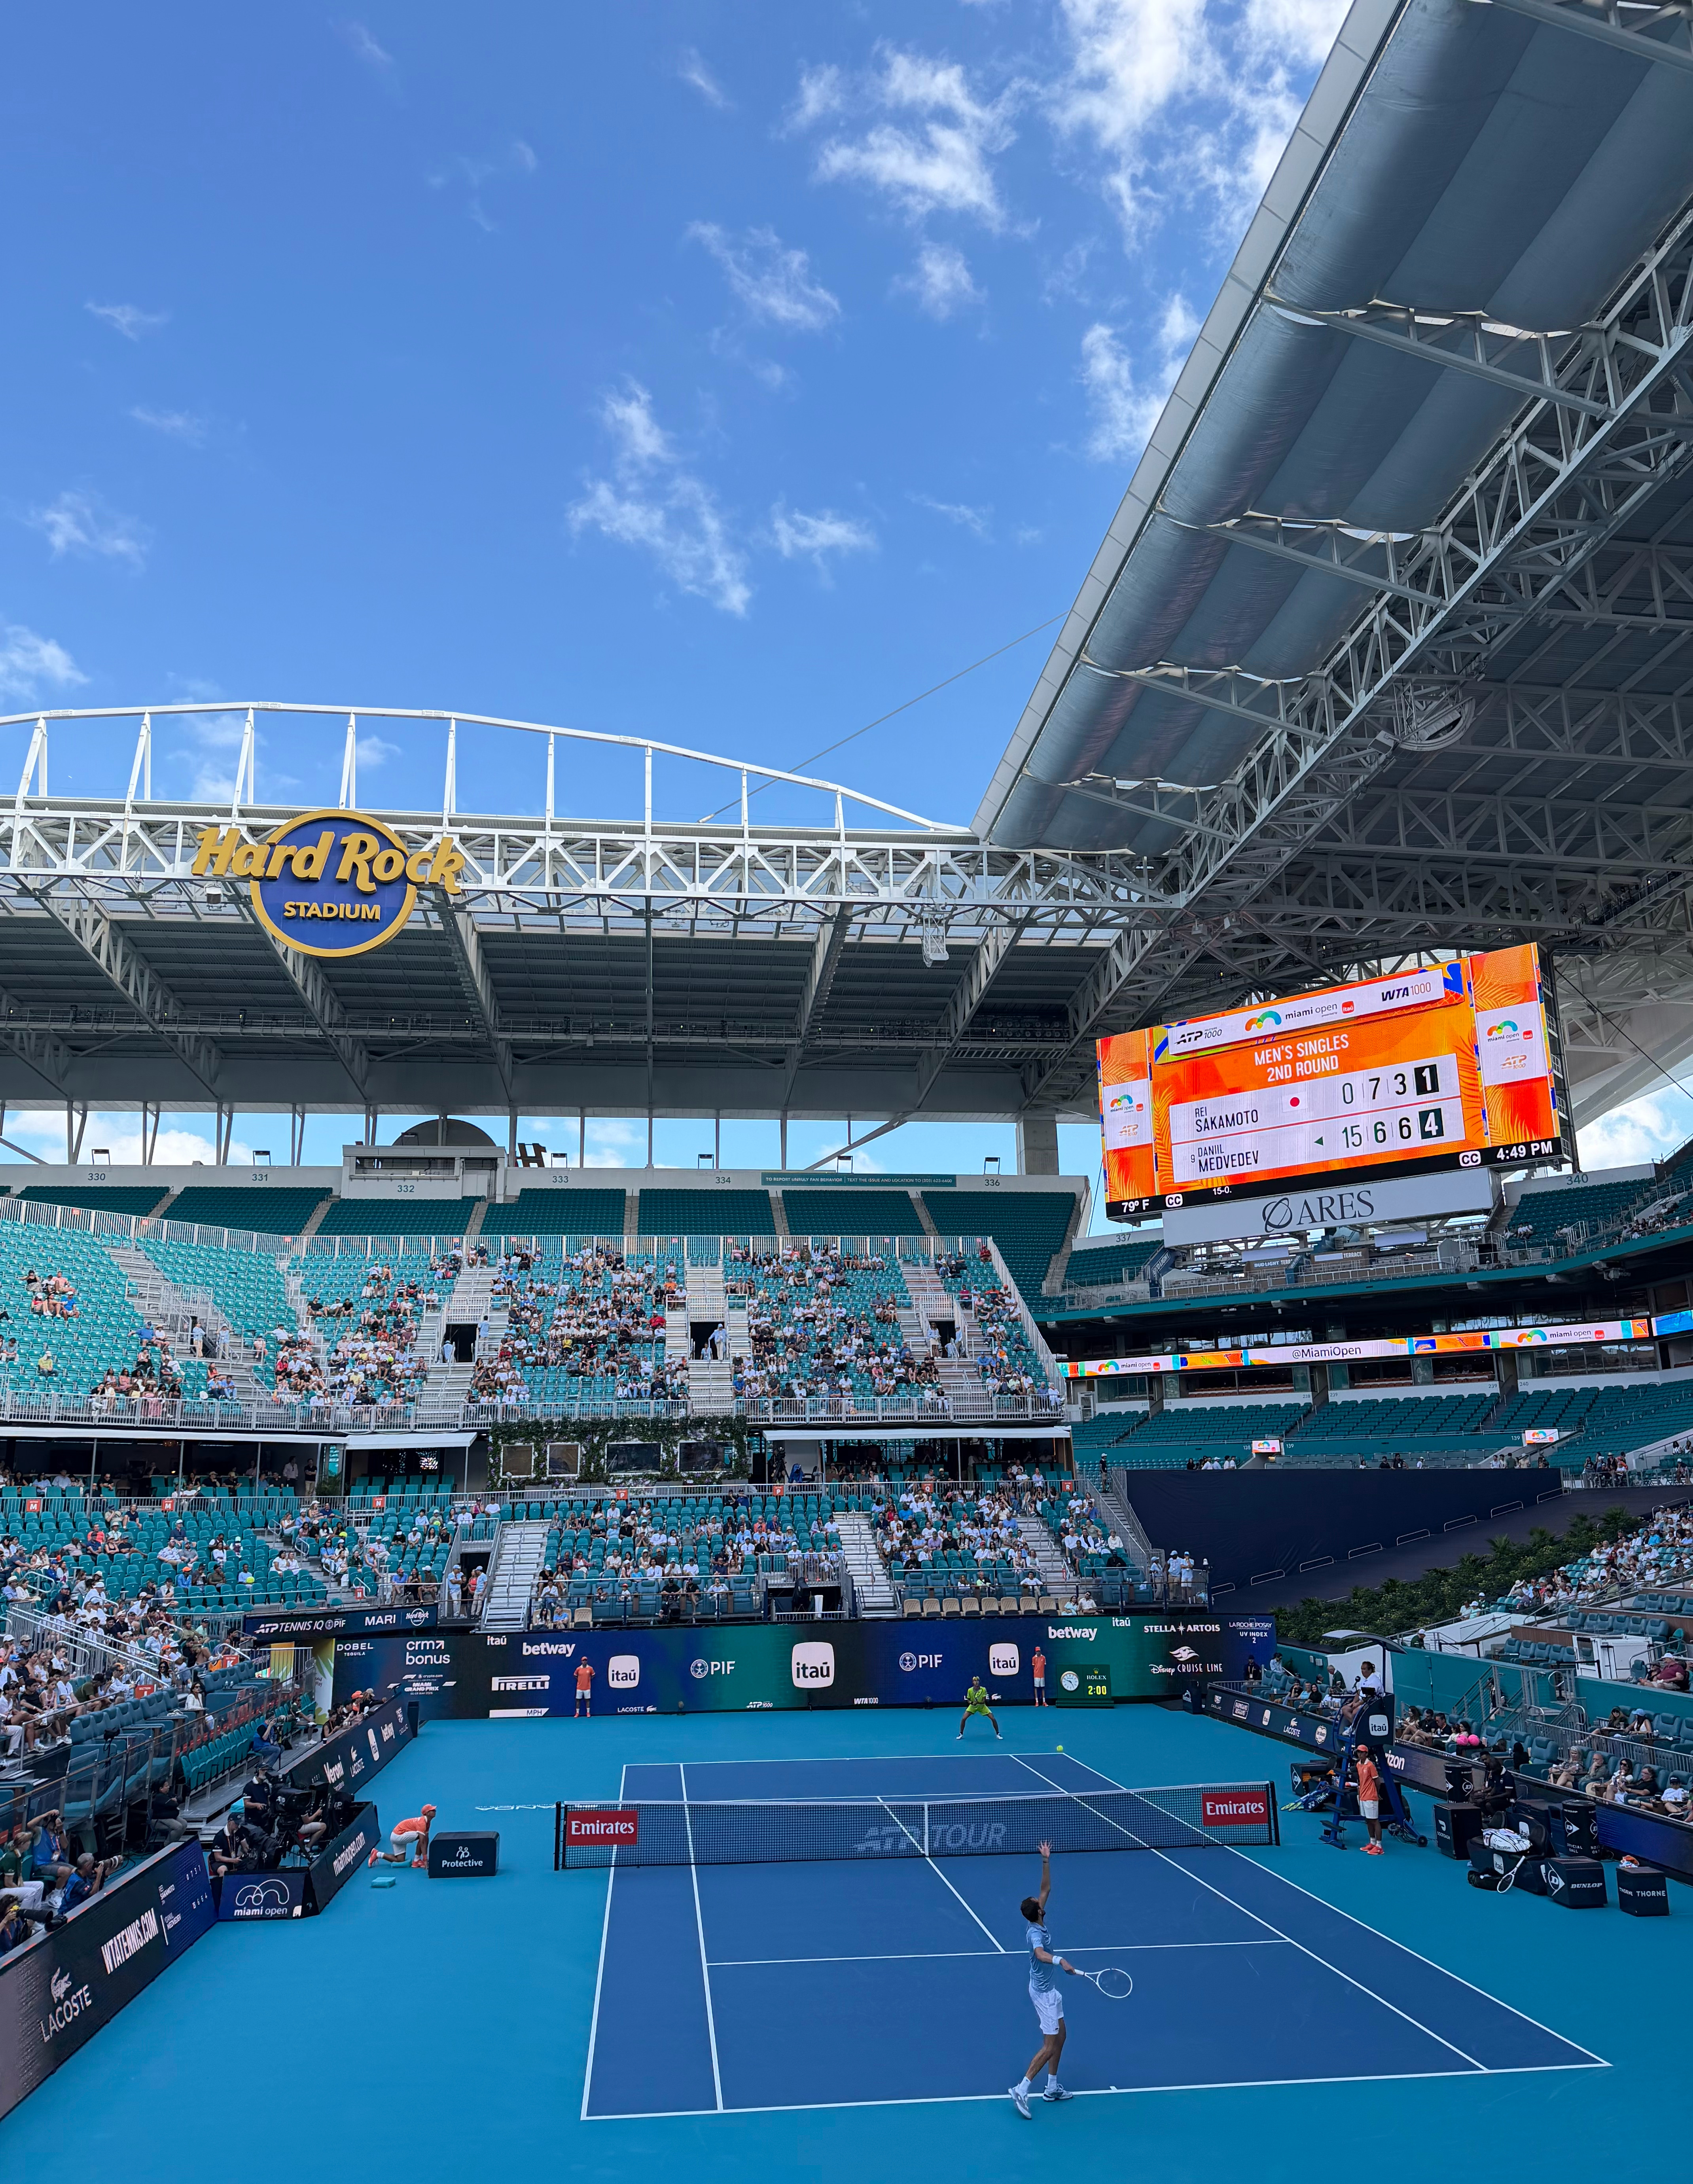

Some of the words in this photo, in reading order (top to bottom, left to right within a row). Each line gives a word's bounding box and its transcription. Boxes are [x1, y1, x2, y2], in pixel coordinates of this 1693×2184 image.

[191, 827, 335, 882] Hard
[335, 832, 465, 895] Rock
[283, 901, 381, 921] STADIUM
[1382, 987, 1409, 1001] WTA
[1410, 982, 1432, 995] 1000
[1285, 1007, 1313, 1020] miami
[1315, 1003, 1338, 1014] open
[1174, 1029, 1203, 1045] ATP
[1204, 1028, 1222, 1039] 1000
[1254, 1045, 1293, 1065] MEN'S
[1297, 1033, 1350, 1056] SINGLES
[1500, 1054, 1527, 1066] ATP
[1267, 1062, 1292, 1082] 2ND
[1296, 1055, 1339, 1076] ROUND
[1196, 1109, 1259, 1132] SAKAMOTO
[1342, 1083, 1353, 1104] 0
[1369, 1077, 1380, 1100] 7
[1394, 1073, 1407, 1095] 3
[1422, 1068, 1432, 1091] 1
[1195, 1107, 1207, 1118] REI
[1118, 1124, 1139, 1135] ATP
[1199, 1150, 1259, 1173] MEDVEDEV
[1342, 1124, 1362, 1148] 15
[1374, 1121, 1386, 1143] 6
[1399, 1117, 1411, 1139] 6
[1425, 1112, 1438, 1136] 4
[1191, 1155, 1195, 1163] 9
[1198, 1144, 1225, 1157] DANIIL
[1461, 1154, 1479, 1164] CC
[1496, 1148, 1526, 1160] 4:49
[1531, 1141, 1553, 1155] PM
[1566, 1174, 1589, 1185] 340
[1213, 1187, 1232, 1195] 15-0.
[1142, 1199, 1149, 1210] F
[1298, 1191, 1374, 1226] ARES
[1116, 1233, 1131, 1242] 337
[1292, 1346, 1361, 1359] @MiamiOpen
[254, 1623, 278, 1634] ATP
[279, 1621, 312, 1632] TENNIS
[313, 1620, 324, 1630] IQ
[334, 1620, 346, 1628] PIF
[365, 1614, 396, 1626] MARI
[1112, 1617, 1131, 1627] itaú
[1048, 1626, 1098, 1641] betway
[337, 1643, 373, 1651] DOBEL
[406, 1640, 435, 1651] crm
[487, 1636, 507, 1646] itaú
[522, 1642, 576, 1657] betway
[405, 1651, 450, 1665] bonus
[918, 1654, 943, 1668] PIF
[992, 1657, 1016, 1669] itaú
[611, 1668, 636, 1682] itaú
[710, 1661, 735, 1675] PIF
[796, 1662, 830, 1679] itaú
[1149, 1664, 1175, 1675] Disney
[1177, 1663, 1203, 1673] CRUISE
[1206, 1663, 1223, 1672] LINE
[491, 1675, 550, 1691] PIRELLI
[1088, 1685, 1107, 1695] 2:00
[1283, 1725, 1301, 1737] LACOSTE
[324, 1754, 344, 1784] Veroni
[1206, 1801, 1264, 1816] Emirates
[571, 1820, 634, 1835] Emirates
[932, 1823, 1007, 1848] TOUR
[333, 1831, 366, 1877] miamiopen.com
[442, 1860, 483, 1868] Protective
[1494, 1861, 1503, 1869] itaú
[1619, 1887, 1633, 1896] THORNE
[234, 1906, 263, 1916] miami
[265, 1907, 287, 1917] open
[101, 1907, 158, 1975] WTATENNIS.COM
[40, 1984, 92, 2043] LACOSTE
